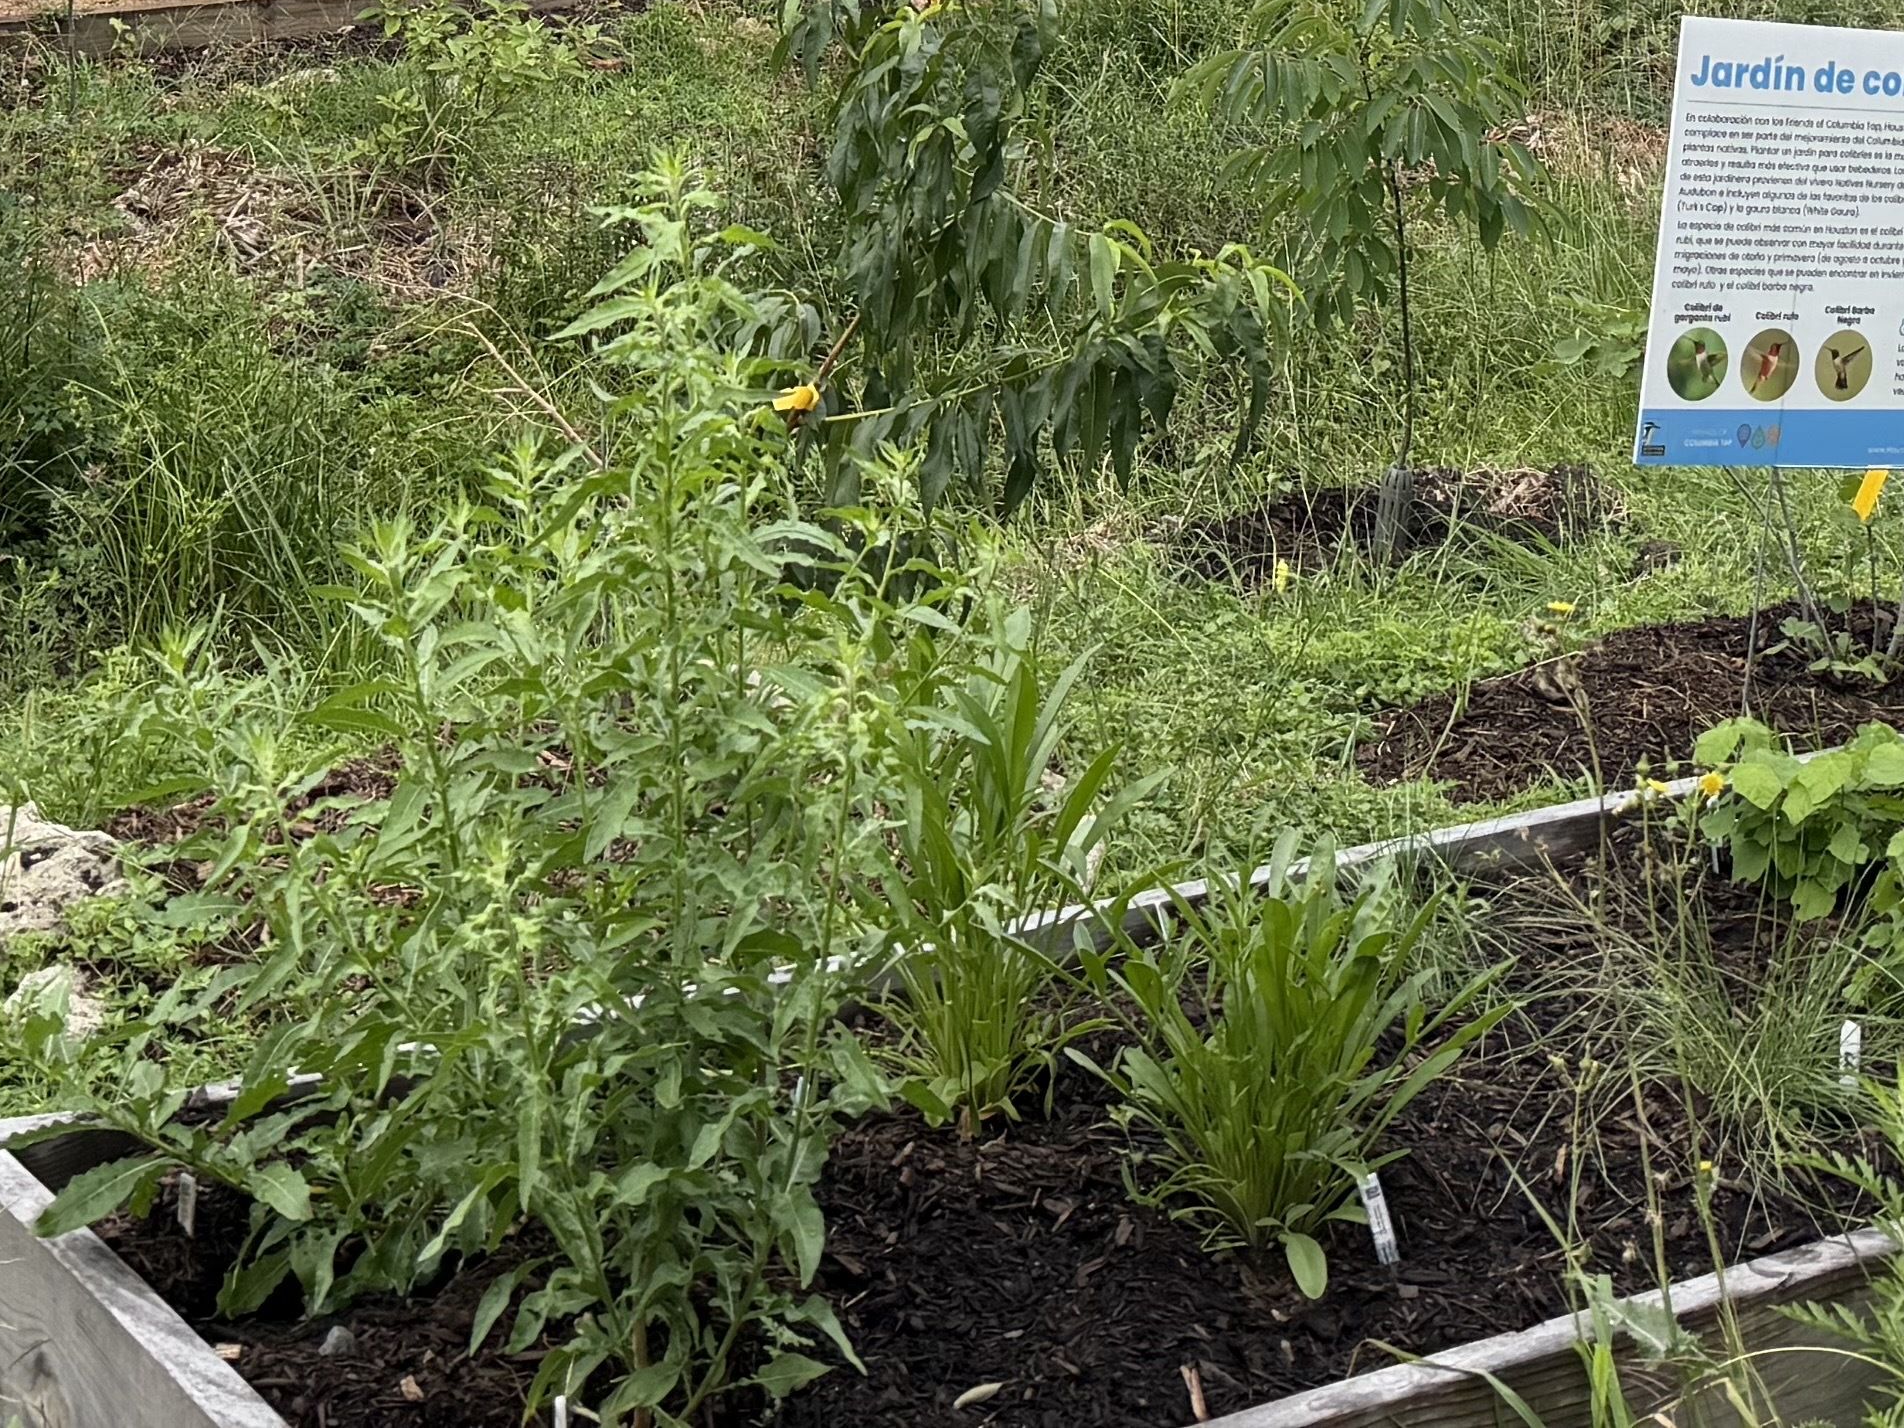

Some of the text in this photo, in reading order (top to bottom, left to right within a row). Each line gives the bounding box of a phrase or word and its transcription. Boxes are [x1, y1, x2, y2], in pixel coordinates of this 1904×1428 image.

[1690, 54, 1805, 91] Jardín
[1813, 60, 1855, 94] de
[1825, 119, 1864, 130] Columbia
[1866, 135, 1904, 146] Columbia
[1825, 224, 1858, 234] Houston
